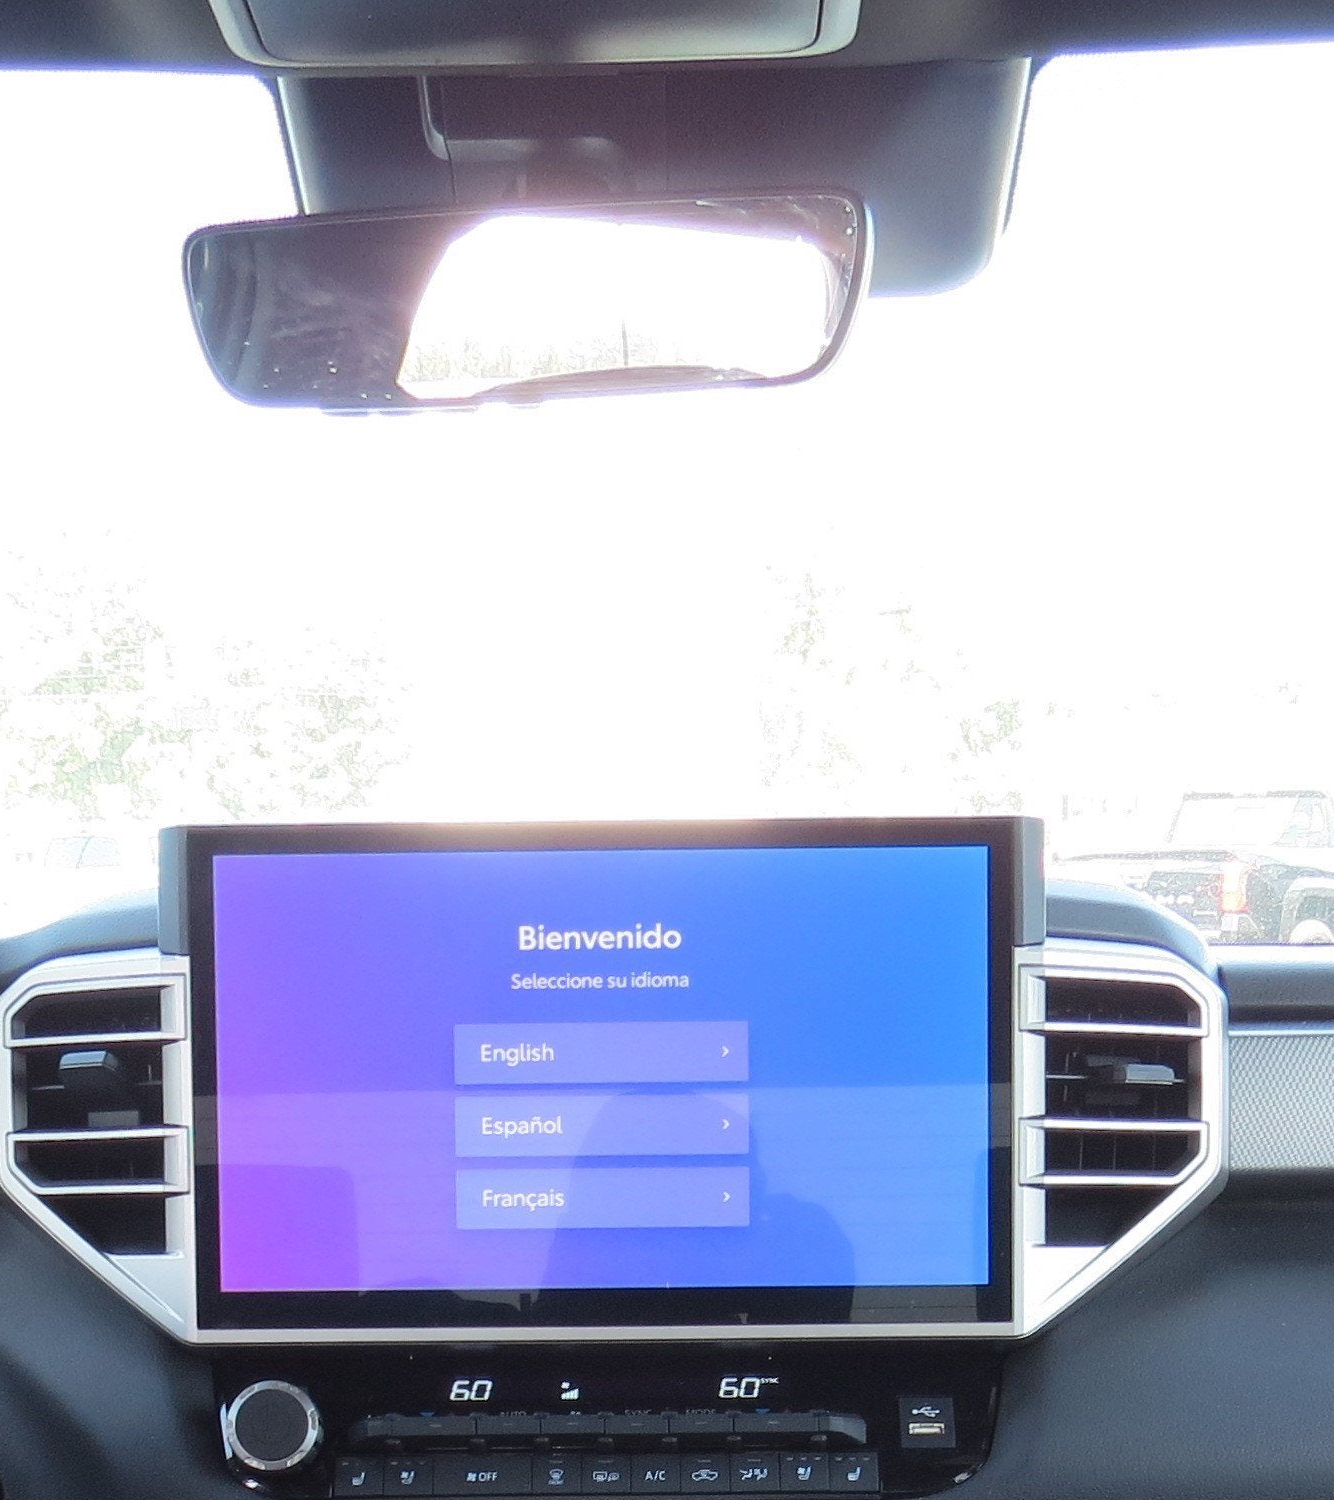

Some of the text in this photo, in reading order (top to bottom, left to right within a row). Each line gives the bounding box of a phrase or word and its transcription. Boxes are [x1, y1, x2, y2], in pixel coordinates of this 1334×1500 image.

[518, 923, 683, 952] Bienvenido
[511, 970, 690, 990] Seleccione su idioma
[480, 1042, 555, 1066] English
[481, 1113, 563, 1139] Español
[481, 1186, 565, 1212] Français
[449, 1379, 494, 1402] 60
[718, 1377, 760, 1399] 60
[478, 1471, 498, 1482] OFF
[644, 1470, 666, 1482] A/C
